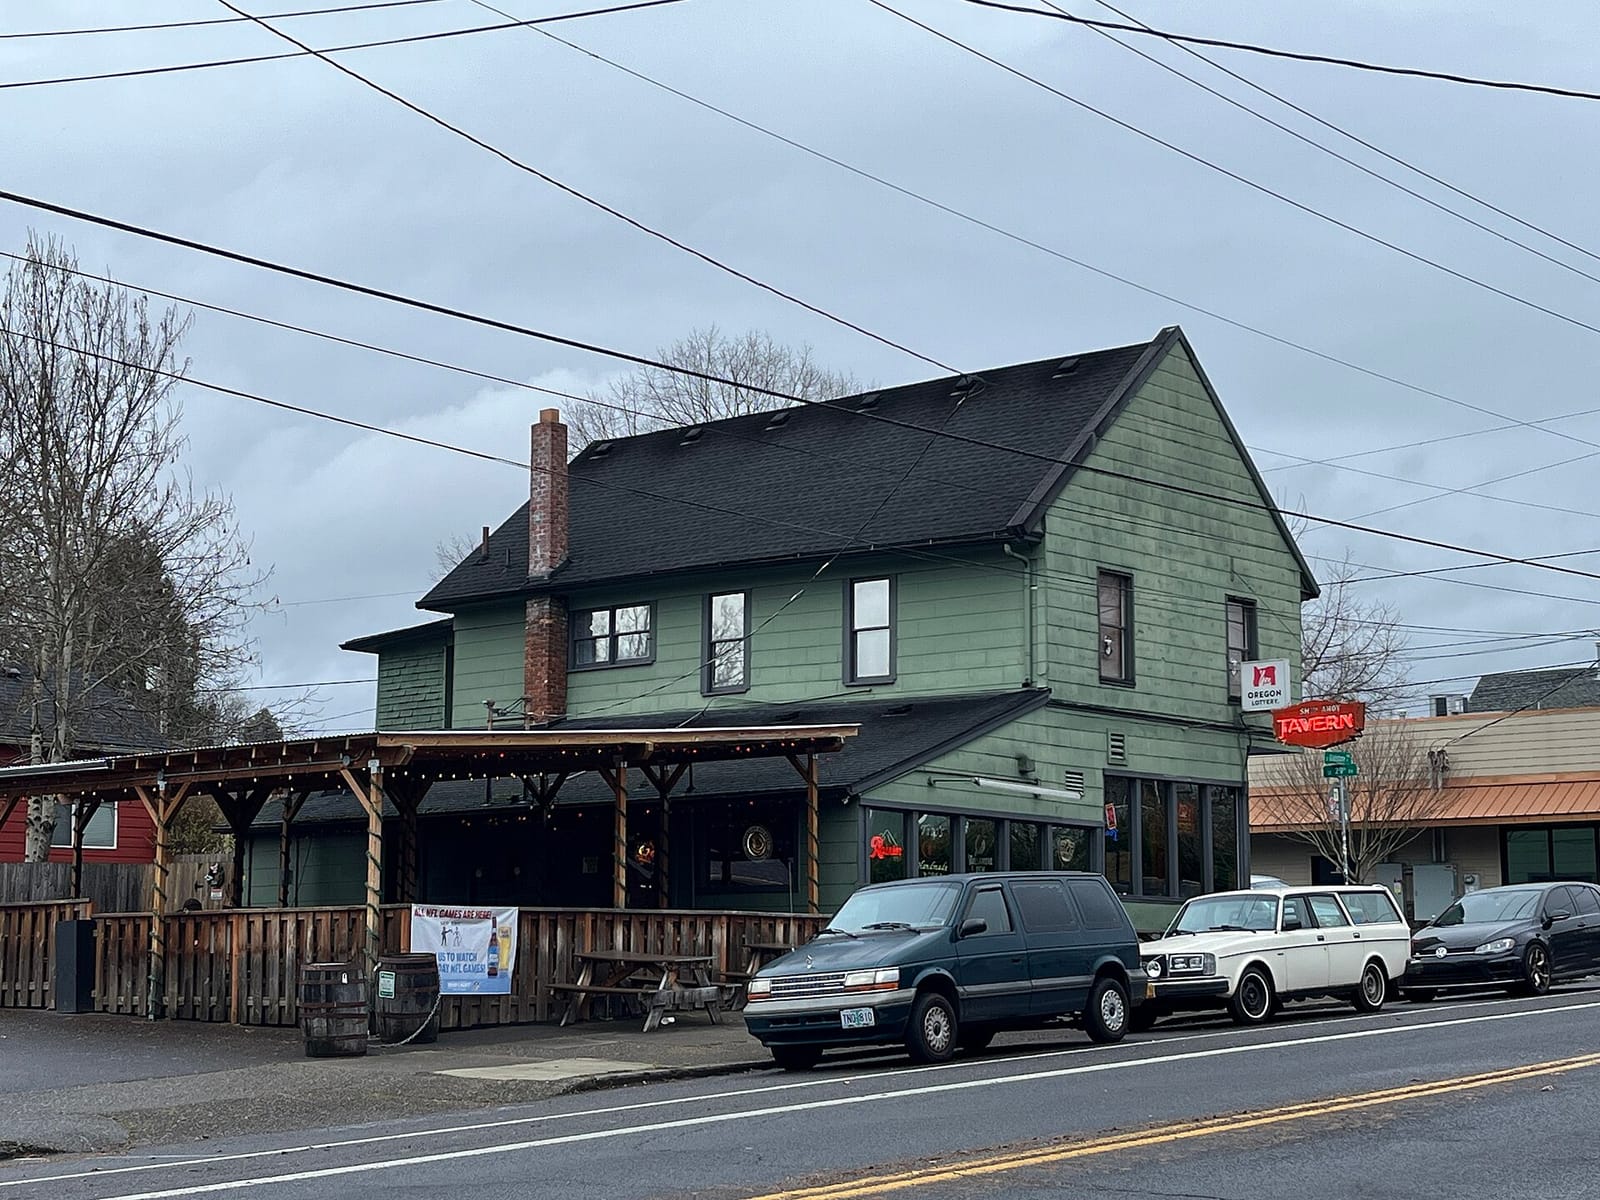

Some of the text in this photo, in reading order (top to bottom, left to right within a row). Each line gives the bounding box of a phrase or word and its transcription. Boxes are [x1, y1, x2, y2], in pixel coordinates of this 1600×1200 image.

[1247, 689, 1282, 699] OREGON
[1277, 713, 1354, 740] TAVERN
[414, 908, 425, 917] ALL
[426, 908, 438, 918] NFL
[439, 909, 462, 919] GAMES
[463, 910, 475, 919] ARE
[447, 952, 455, 962] TO
[456, 952, 477, 962] WATCH
[451, 963, 462, 974] NFL
[463, 963, 486, 974] GAMES!
